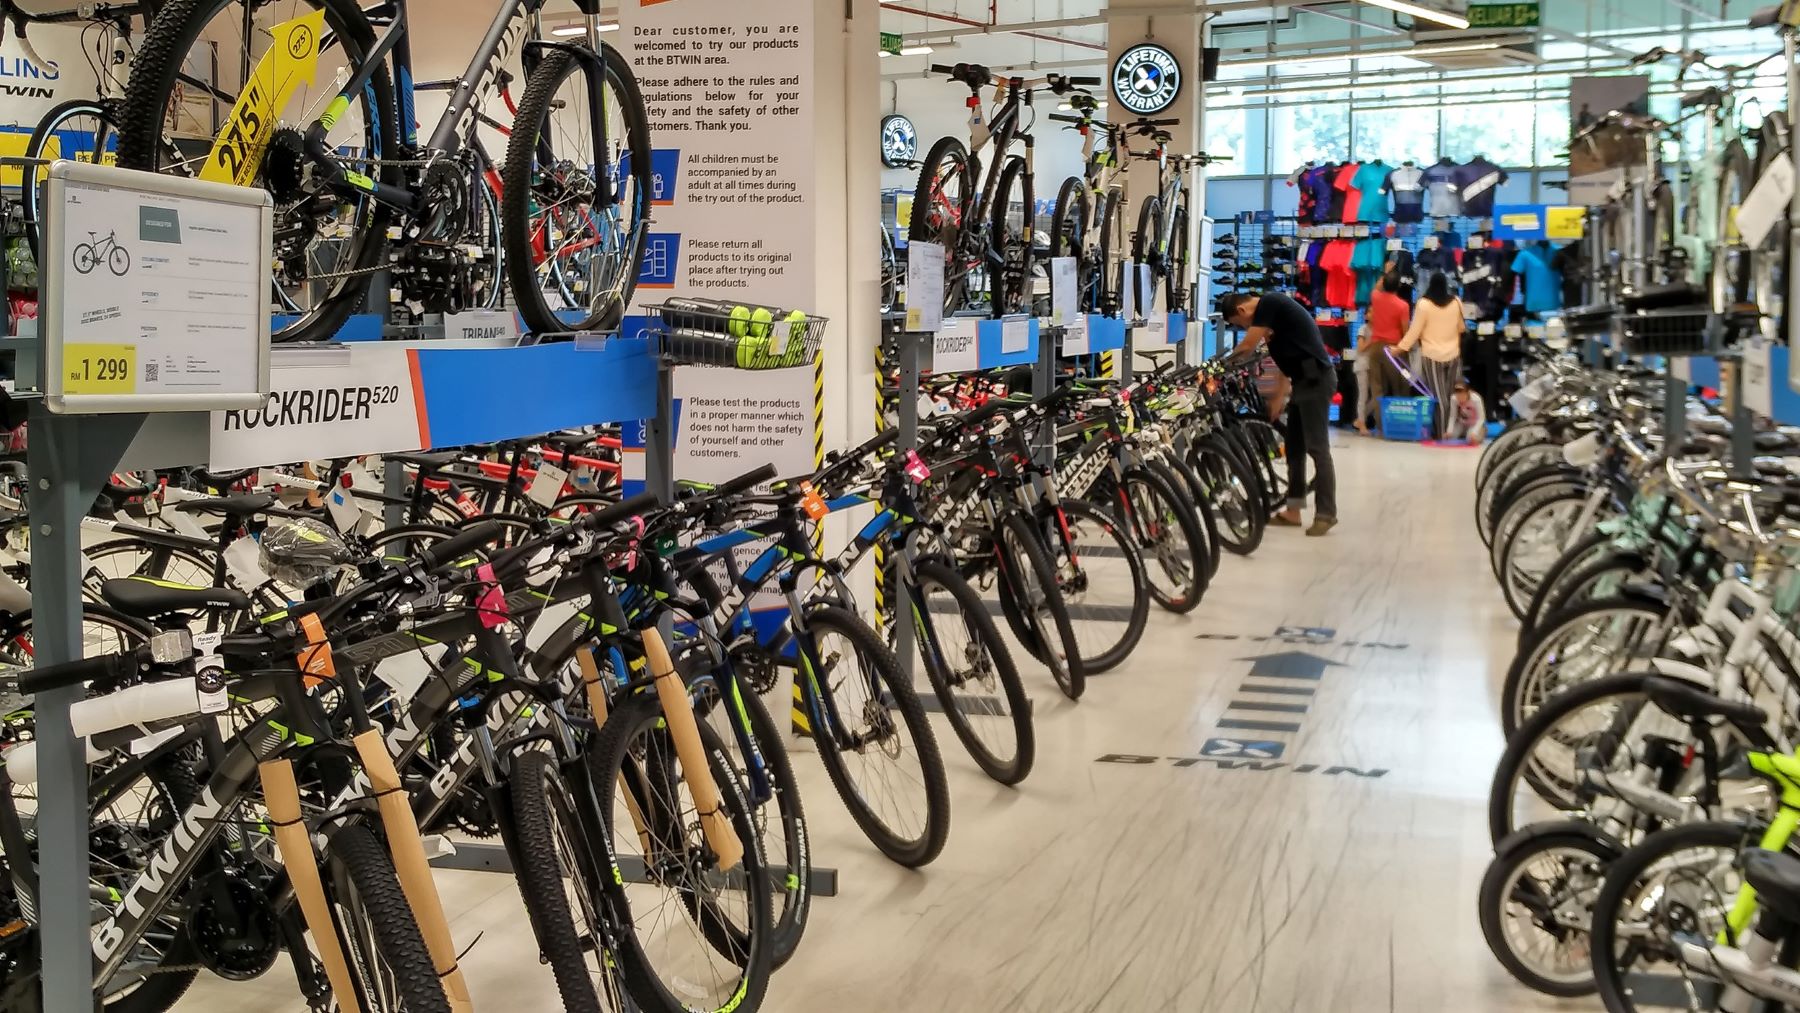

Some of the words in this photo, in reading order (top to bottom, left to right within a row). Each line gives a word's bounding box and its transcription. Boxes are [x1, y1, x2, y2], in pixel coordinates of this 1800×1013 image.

[634, 26, 662, 36] Dear
[672, 25, 736, 36] customer,
[746, 25, 768, 37] you
[779, 25, 799, 34] are
[634, 40, 686, 50] welcomed
[692, 41, 702, 50] to
[709, 40, 723, 52] try
[729, 40, 746, 49] our
[752, 39, 799, 51] products
[634, 56, 644, 66] at
[647, 56, 664, 66] the
[666, 55, 701, 65] BTWIN
[704, 56, 730, 65] area.
[1121, 50, 1175, 77] LIFETIME
[635, 77, 669, 87] Please
[673, 76, 709, 87] adhere
[713, 77, 724, 86] to
[728, 76, 745, 86] the
[750, 76, 775, 86] rules
[779, 75, 799, 85] and
[640, 91, 693, 102] egulations
[705, 91, 736, 101] below
[749, 90, 763, 101] for
[776, 91, 800, 102] your
[1117, 77, 1174, 109] WARRANTY
[646, 106, 667, 117] fety
[672, 106, 691, 116] and
[696, 106, 713, 116] the
[718, 106, 751, 117] safety
[756, 105, 767, 116] of
[772, 105, 800, 116] other
[648, 121, 692, 131] stomers.
[695, 120, 727, 131] Thank
[729, 121, 751, 133] you.
[688, 154, 700, 164] All
[702, 154, 739, 164] children
[741, 155, 765, 164] must
[767, 154, 779, 164] be
[688, 167, 750, 178] accompanied
[751, 167, 763, 178] by
[765, 168, 777, 177] an
[688, 180, 711, 190] adult
[713, 181, 723, 190] at
[725, 180, 736, 190] all
[738, 180, 765, 190] times
[767, 180, 796, 192] during
[688, 194, 703, 203] the
[705, 194, 717, 205] try
[719, 194, 735, 203] out
[737, 193, 748, 203] of
[749, 193, 765, 203] the
[766, 193, 805, 205] product.
[688, 240, 719, 249] Please
[721, 240, 749, 249] return
[751, 239, 763, 249] all
[688, 253, 729, 264] products
[731, 253, 741, 262] to
[743, 253, 755, 262] its
[757, 252, 792, 264] original
[688, 266, 713, 277] place
[715, 265, 738, 275] after
[740, 266, 766, 277] trying
[768, 266, 784, 275] out
[688, 278, 704, 288] the
[705, 278, 750, 290] products.
[71, 373, 81, 381] RM
[82, 358, 90, 381] 1
[97, 357, 128, 381] 299
[690, 397, 721, 407] Please
[723, 398, 740, 407] test
[742, 398, 758, 408] the
[760, 398, 801, 410] products
[690, 410, 699, 419] in
[701, 412, 707, 420] a
[709, 412, 738, 422] proper
[740, 412, 775, 421] manner
[777, 411, 804, 422] which
[690, 423, 712, 432] does
[714, 424, 729, 433] not
[731, 423, 755, 433] harm
[757, 424, 773, 434] the
[775, 424, 803, 436] safety
[690, 435, 700, 445] of
[701, 435, 739, 448] yourself
[740, 437, 758, 446] and
[760, 437, 784, 447] other
[690, 448, 741, 458] customers.
[713, 748, 738, 784] BTWIN
[1094, 753, 1391, 778] BTWIN
